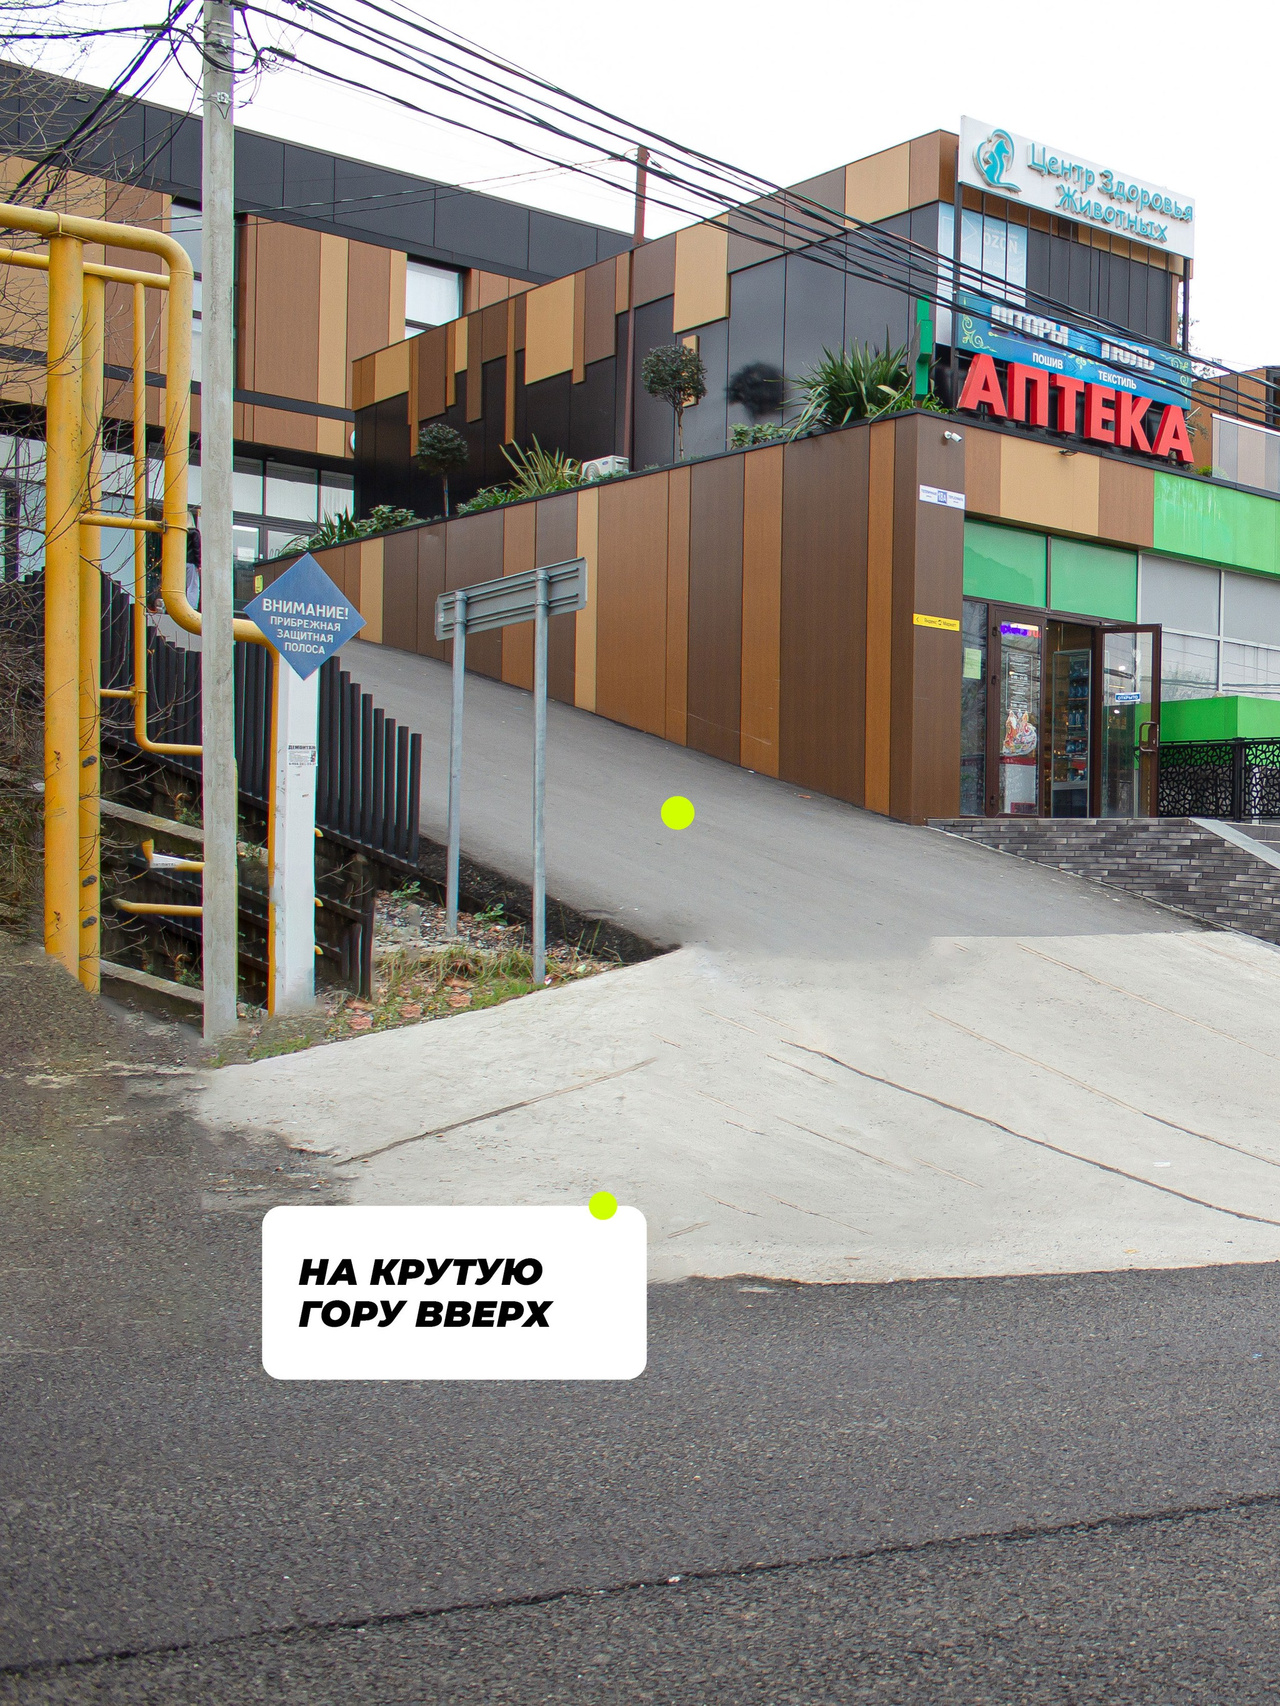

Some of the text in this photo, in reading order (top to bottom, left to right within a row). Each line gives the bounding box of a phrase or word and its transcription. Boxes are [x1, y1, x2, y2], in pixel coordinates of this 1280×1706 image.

[1028, 143, 1194, 222] Центр Здоровья
[1055, 184, 1169, 243] Животных
[991, 304, 1069, 346] ШТОРЫ
[1032, 352, 1064, 370] ПОШИВ
[1098, 370, 1137, 390] ТЕКСТИЛЬ
[958, 353, 1194, 464] АПТЕКА
[262, 598, 349, 620] ВНИМАНИЕ!
[270, 616, 341, 632] ПРИБРЕЖНАЯ
[276, 629, 334, 643] ЗАЩИТНАЯ
[284, 642, 326, 655] ПОЛОСА
